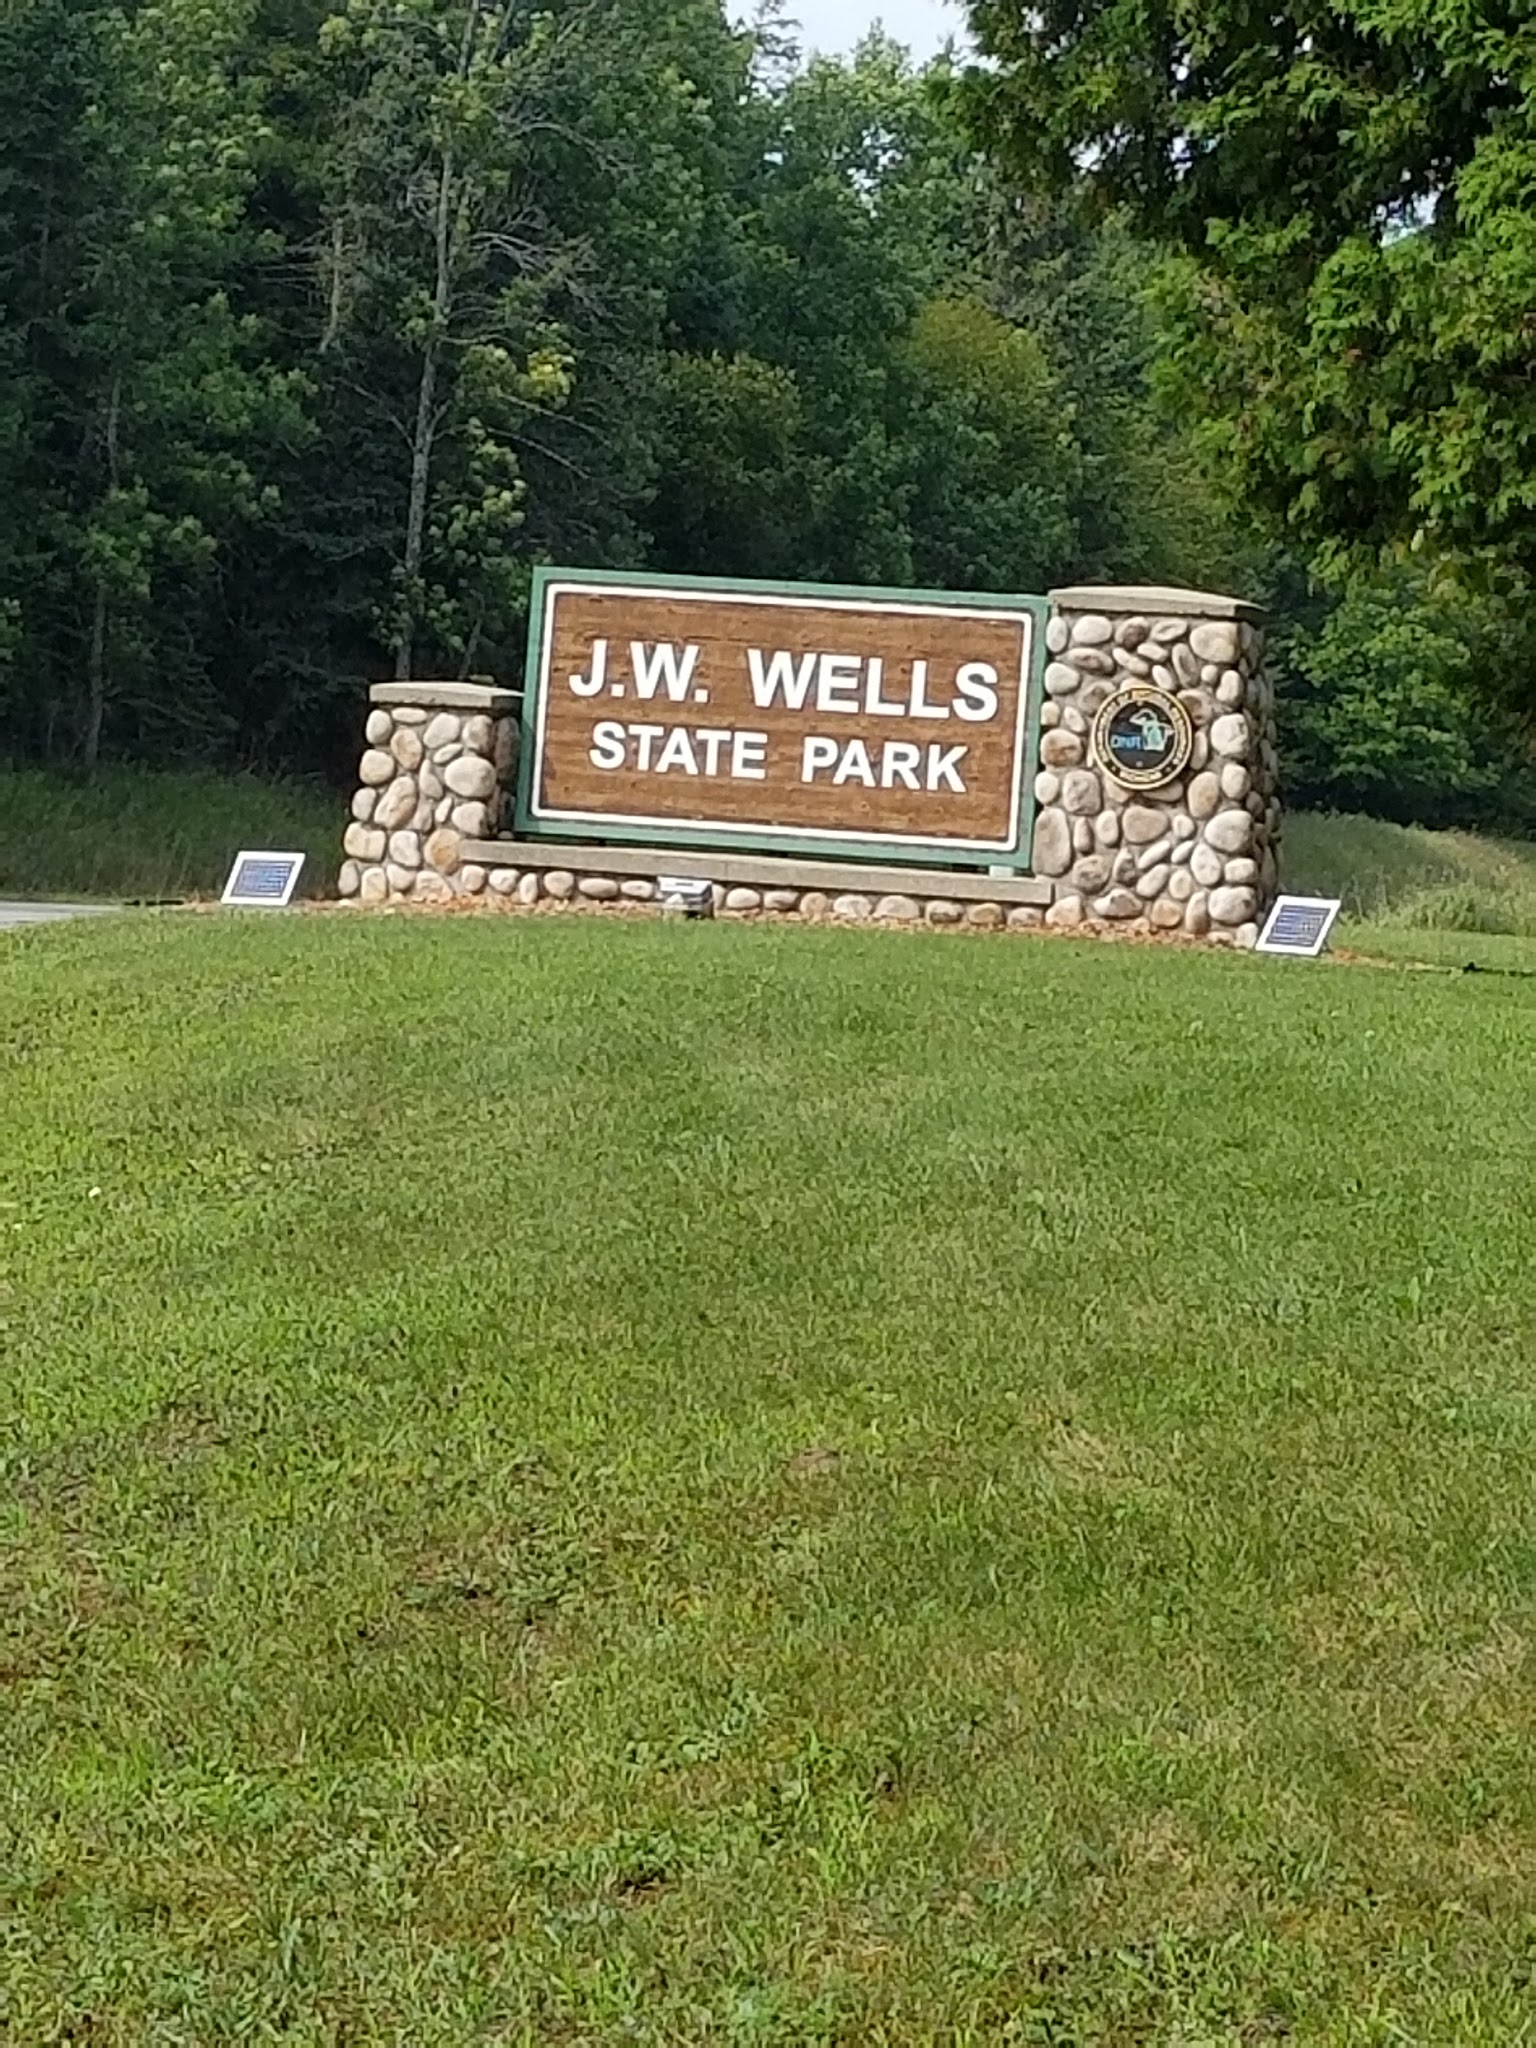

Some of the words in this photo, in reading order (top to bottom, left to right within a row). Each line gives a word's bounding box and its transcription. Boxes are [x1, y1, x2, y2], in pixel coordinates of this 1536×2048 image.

[568, 638, 709, 703] J.W.
[747, 648, 999, 722] WELLS
[588, 721, 768, 780] STATE
[801, 736, 968, 793] PARK
